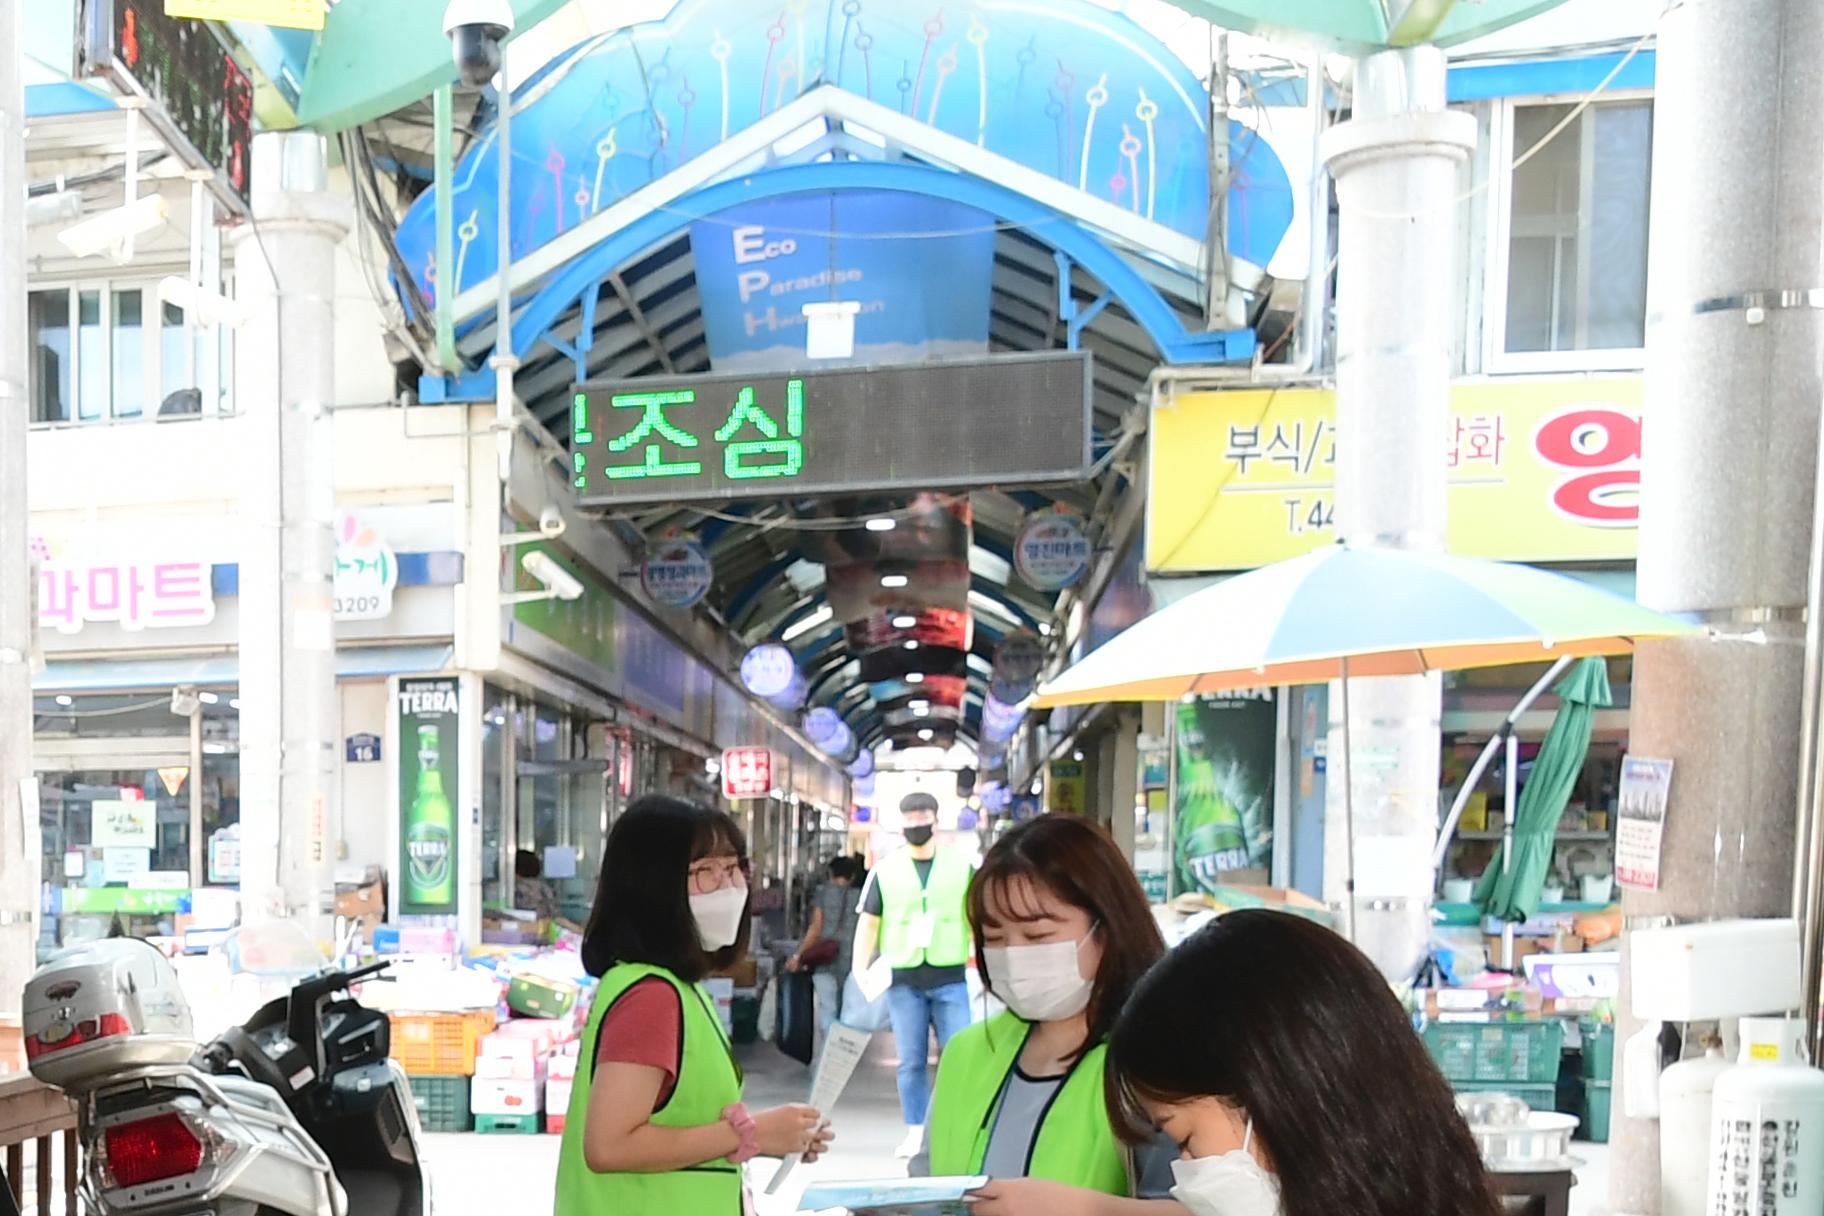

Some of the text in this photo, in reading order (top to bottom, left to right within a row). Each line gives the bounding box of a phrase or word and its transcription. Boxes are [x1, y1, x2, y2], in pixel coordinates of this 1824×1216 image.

[733, 224, 797, 265] Eco
[738, 267, 863, 304] Paradise
[574, 379, 803, 489] 조심
[399, 690, 458, 715] TERRA
